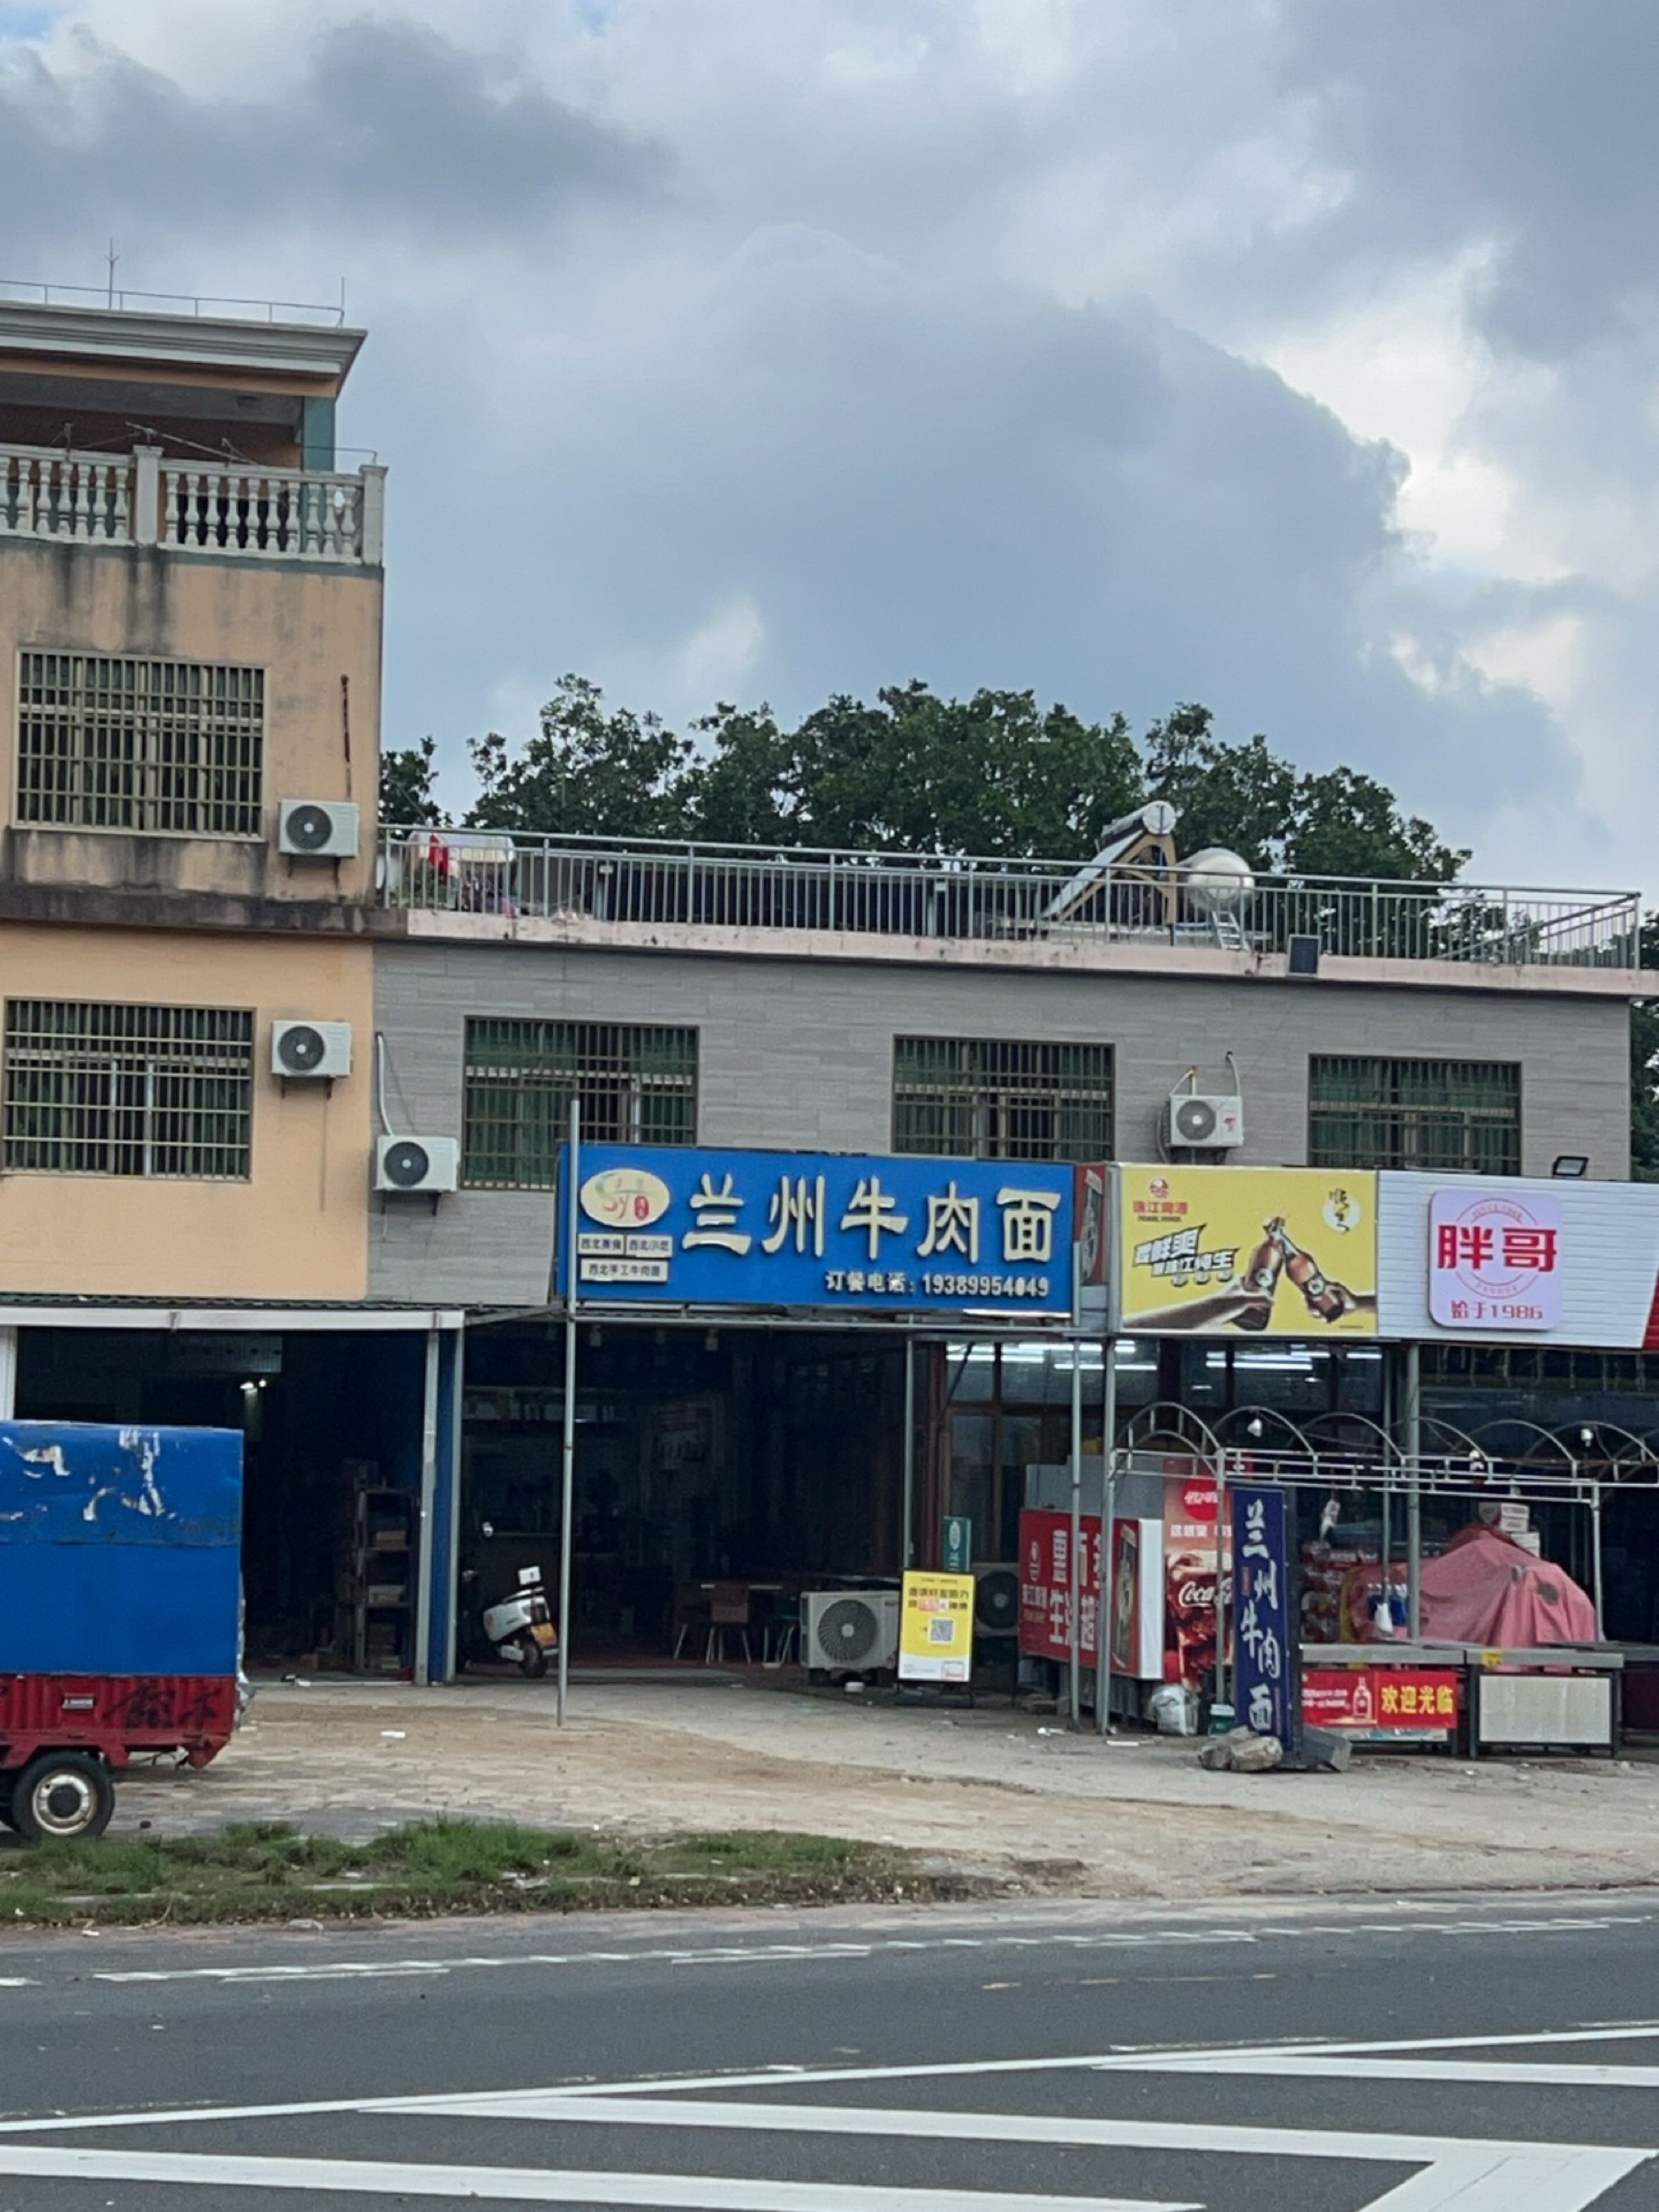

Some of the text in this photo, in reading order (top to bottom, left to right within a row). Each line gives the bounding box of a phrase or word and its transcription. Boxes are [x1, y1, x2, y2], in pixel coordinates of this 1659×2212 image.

[682, 1173, 1061, 1264] 兰州牛肉面
[1152, 1249, 1236, 1275] 珠江纯生
[1437, 1225, 1557, 1272] 胖哥
[922, 1274, 1048, 1297] 19389954049
[1451, 1300, 1544, 1320] 始于1986
[1240, 1498, 1281, 1731] 兰州牛肉面
[1381, 1685, 1454, 1715] 欢迎光临
